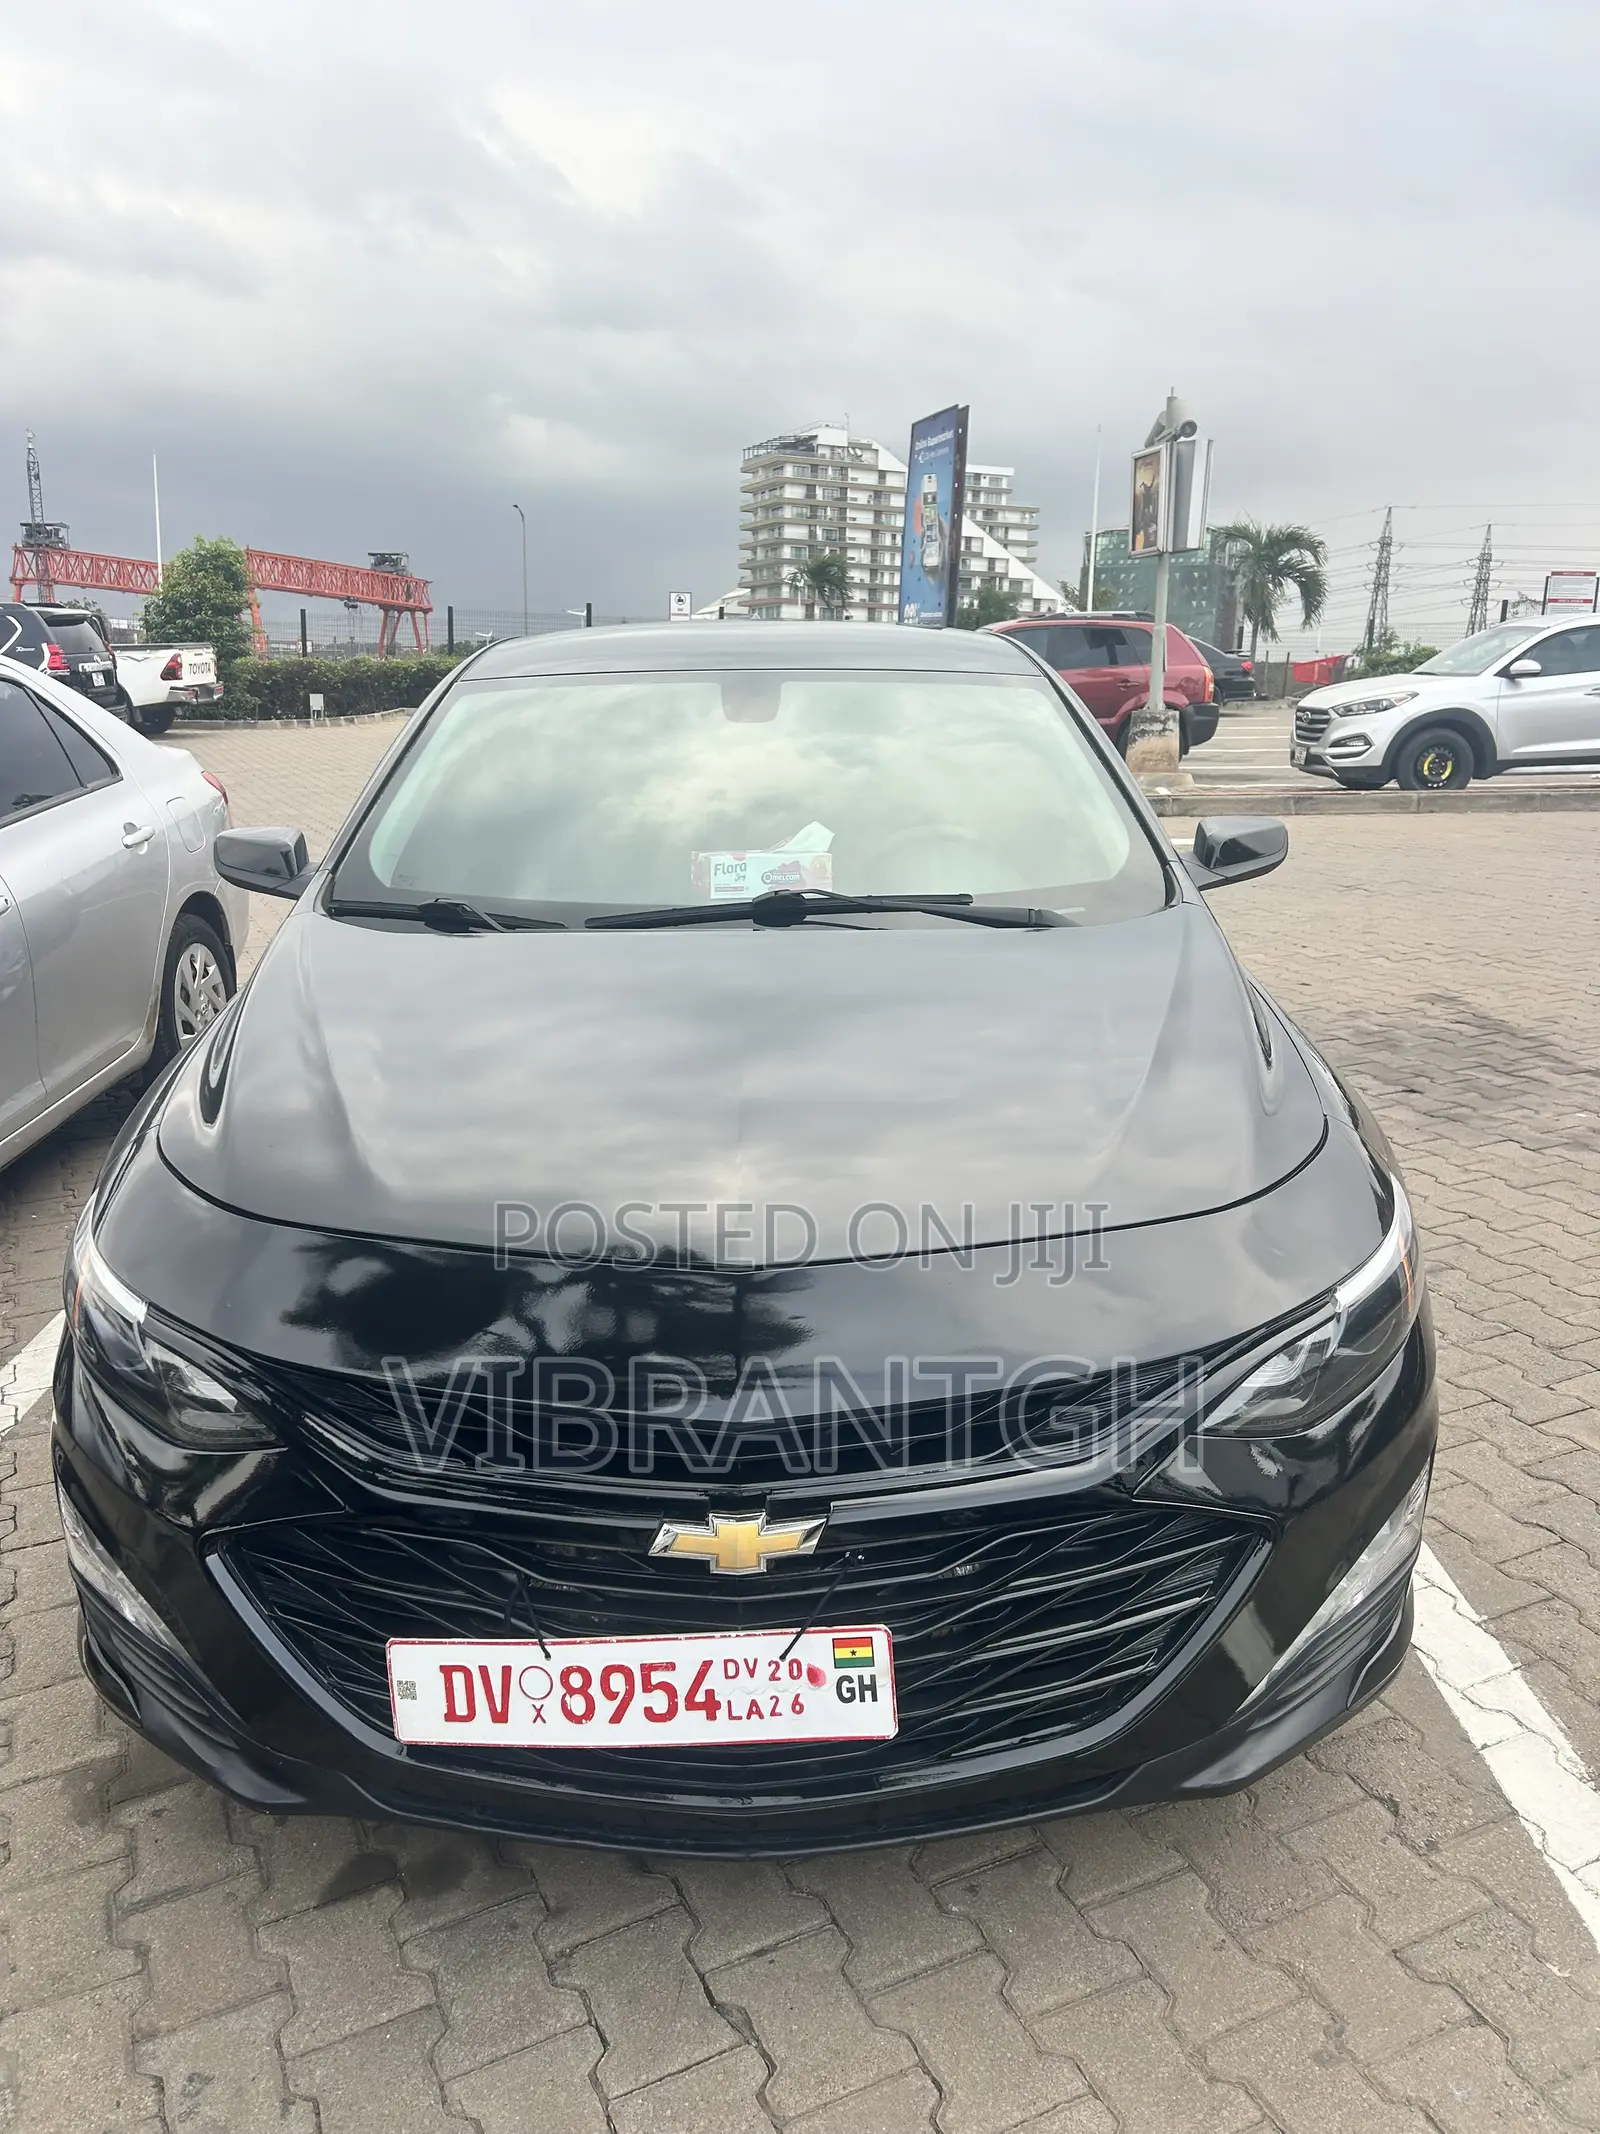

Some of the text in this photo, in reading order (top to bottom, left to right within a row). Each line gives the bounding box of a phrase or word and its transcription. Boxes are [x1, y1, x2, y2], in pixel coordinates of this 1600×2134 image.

[189, 662, 211, 675] TOYOTA
[714, 862, 747, 876] Flora
[723, 1657, 803, 1681] DV 20
[439, 1659, 721, 1725] DV 8954
[836, 1674, 878, 1704] GH
